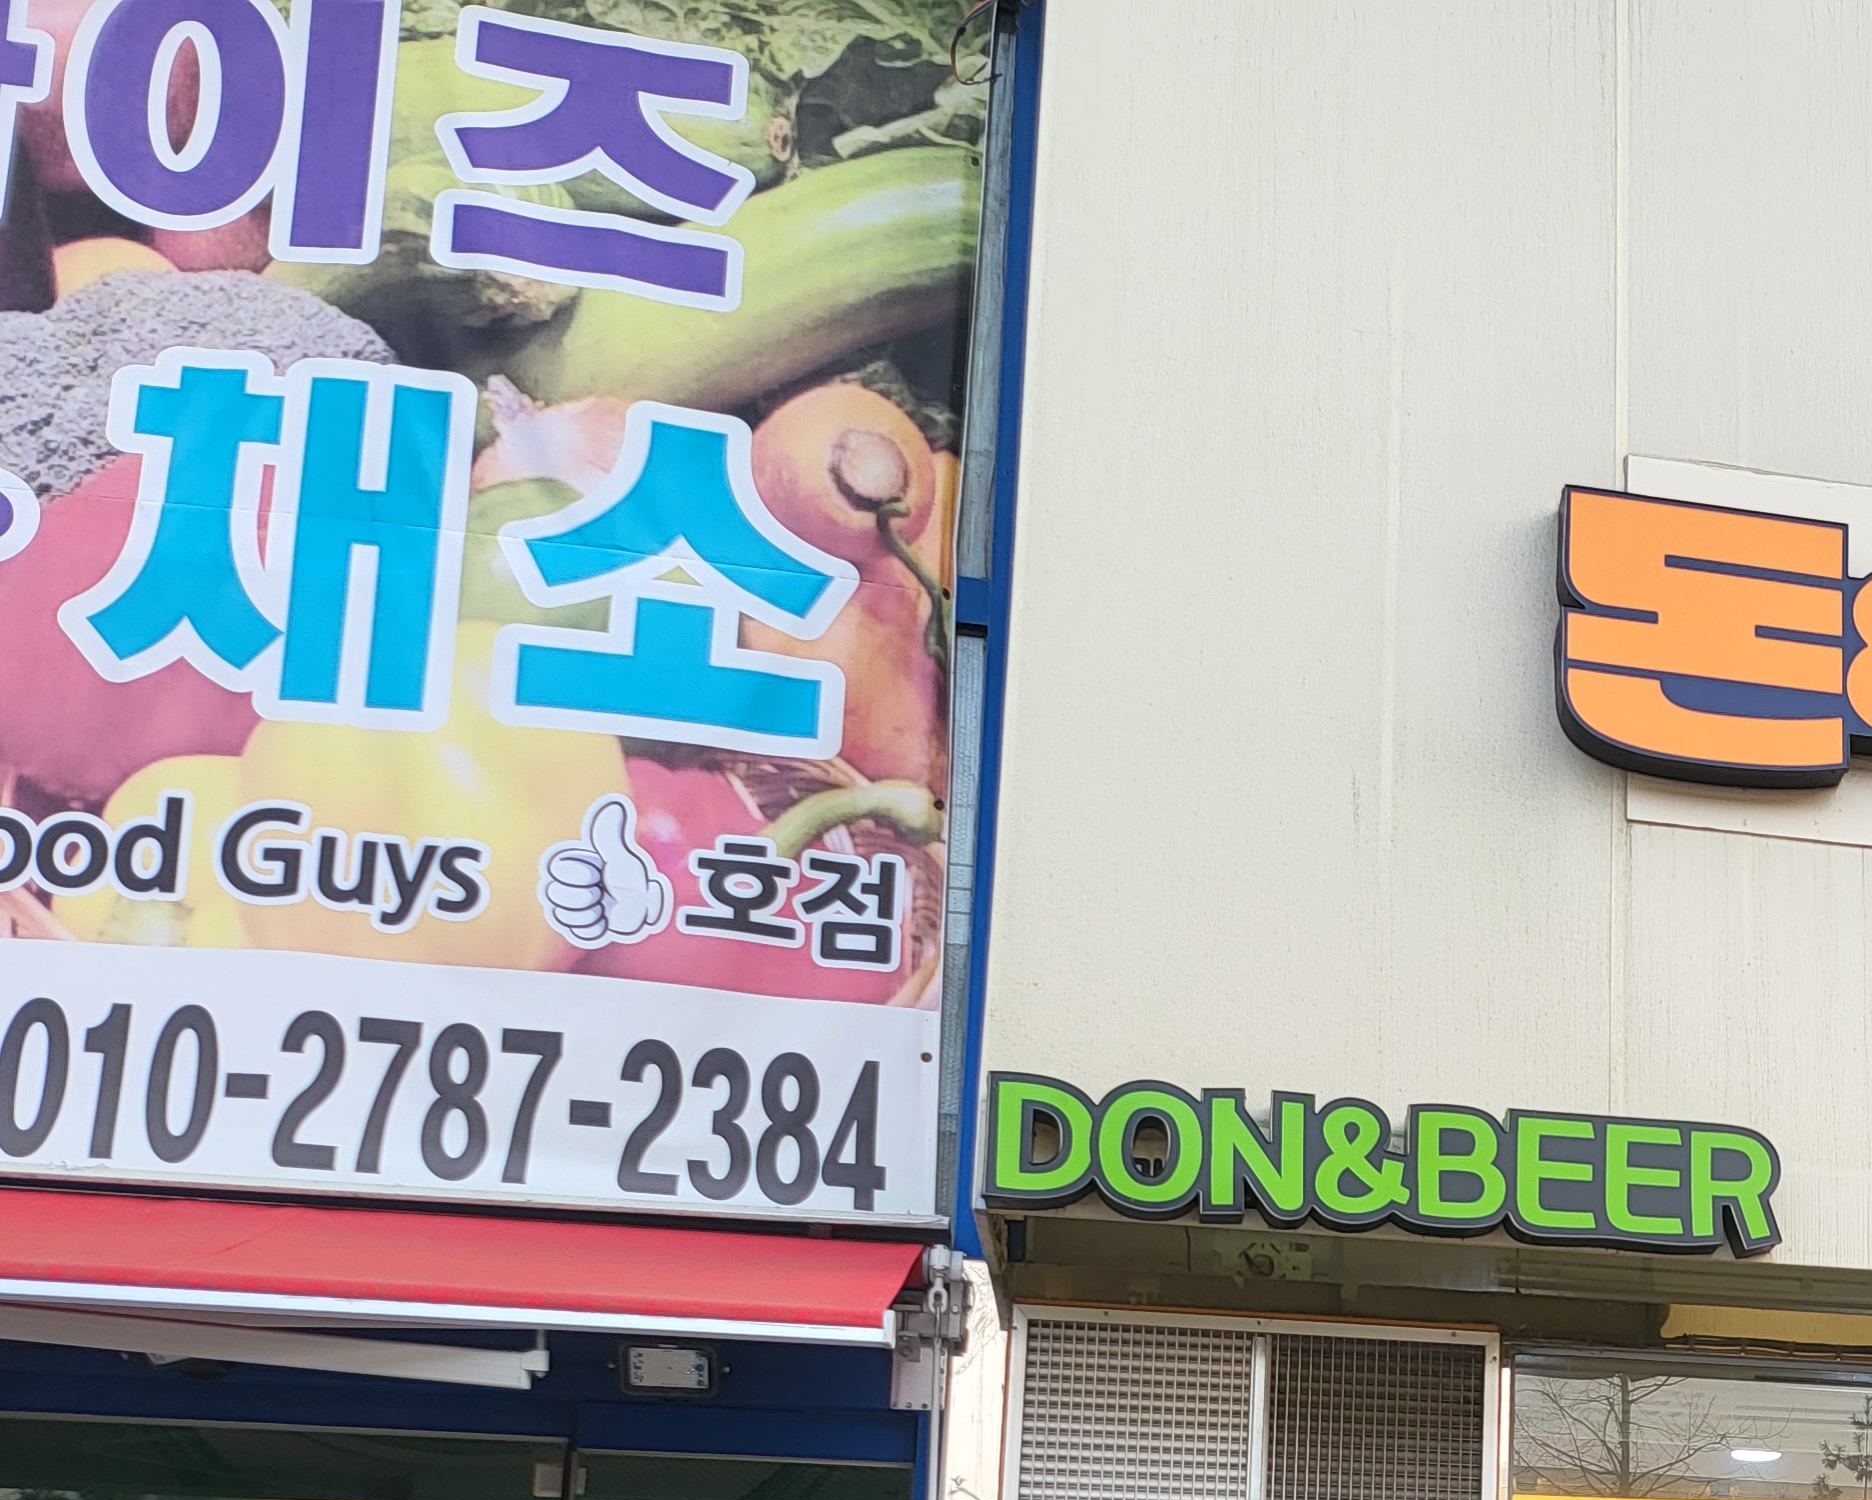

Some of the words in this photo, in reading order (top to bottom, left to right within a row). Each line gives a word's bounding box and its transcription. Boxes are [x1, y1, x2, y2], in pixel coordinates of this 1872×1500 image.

[88, 366, 833, 740] 채소
[222, 804, 482, 925] Guys
[685, 842, 907, 965] 호점
[0, 997, 887, 1211] 010-2787-2384
[988, 1075, 1780, 1250] DON&BEER
